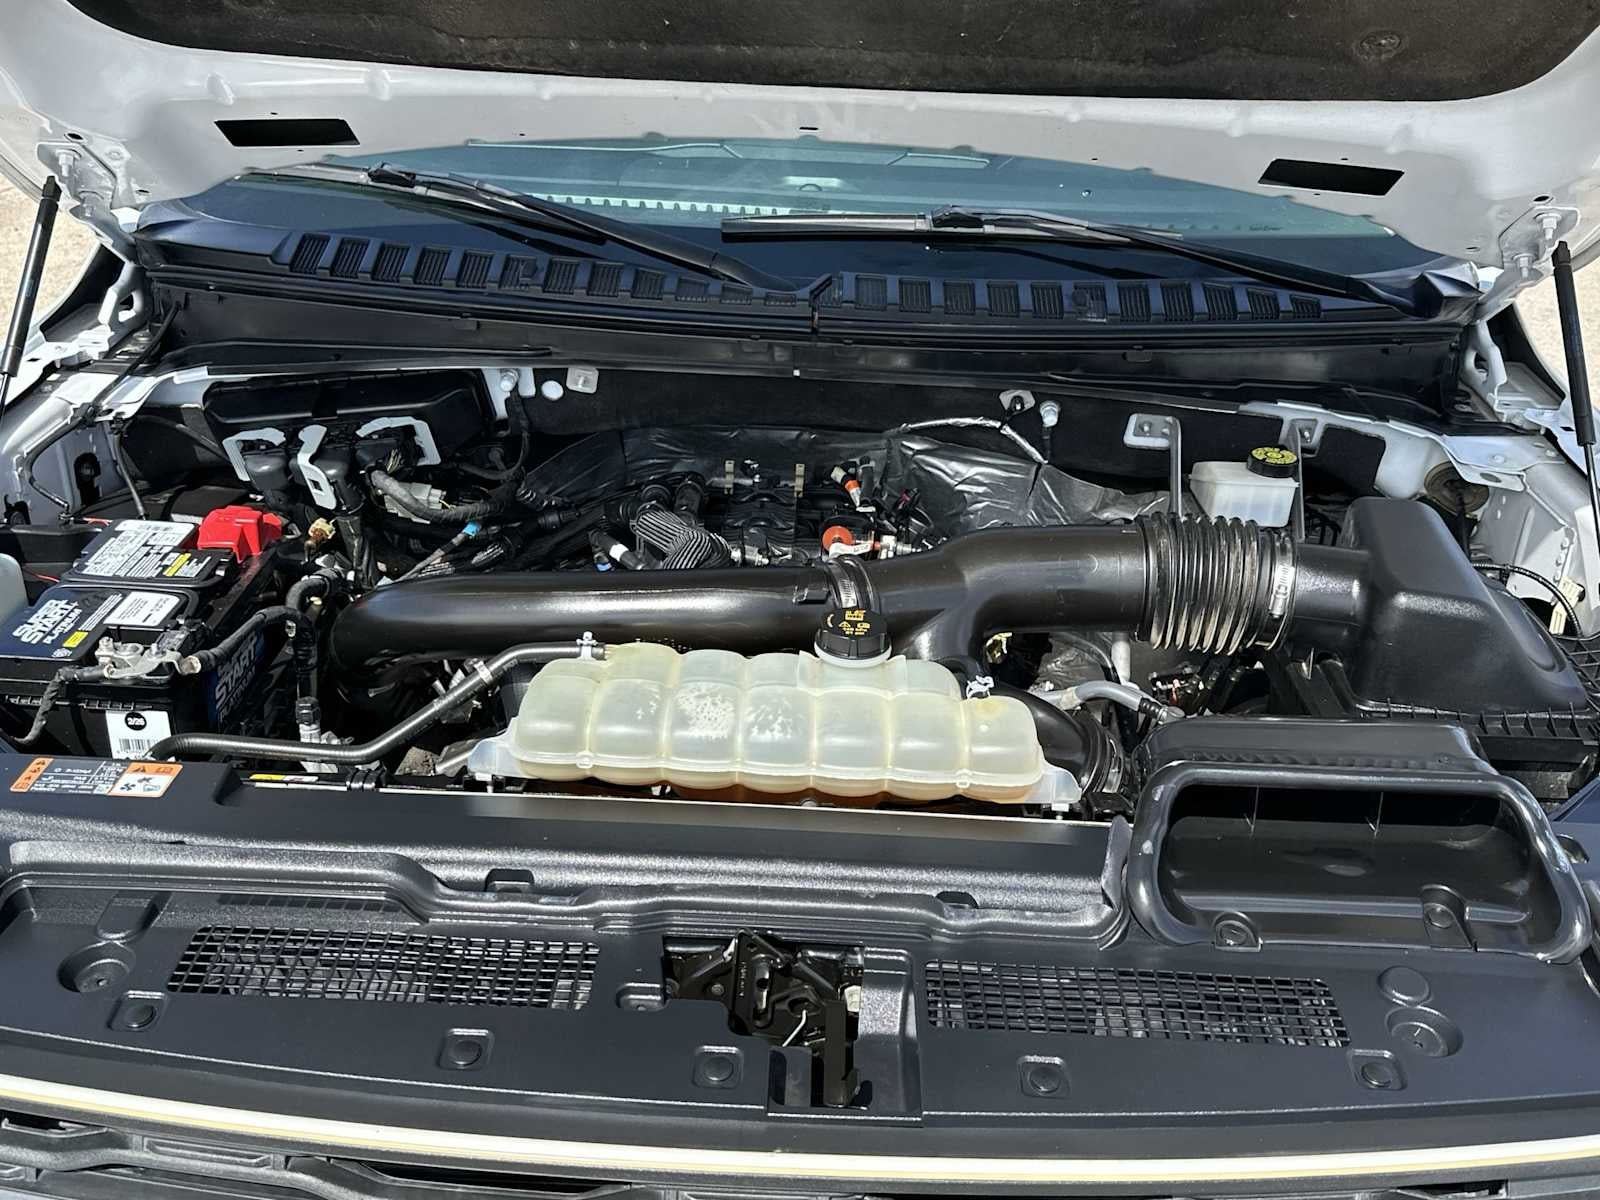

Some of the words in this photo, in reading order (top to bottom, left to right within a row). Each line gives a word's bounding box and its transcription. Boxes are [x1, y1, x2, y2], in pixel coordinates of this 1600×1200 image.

[12, 599, 61, 637] SUPER
[20, 600, 74, 644] START
[215, 643, 256, 711] START
